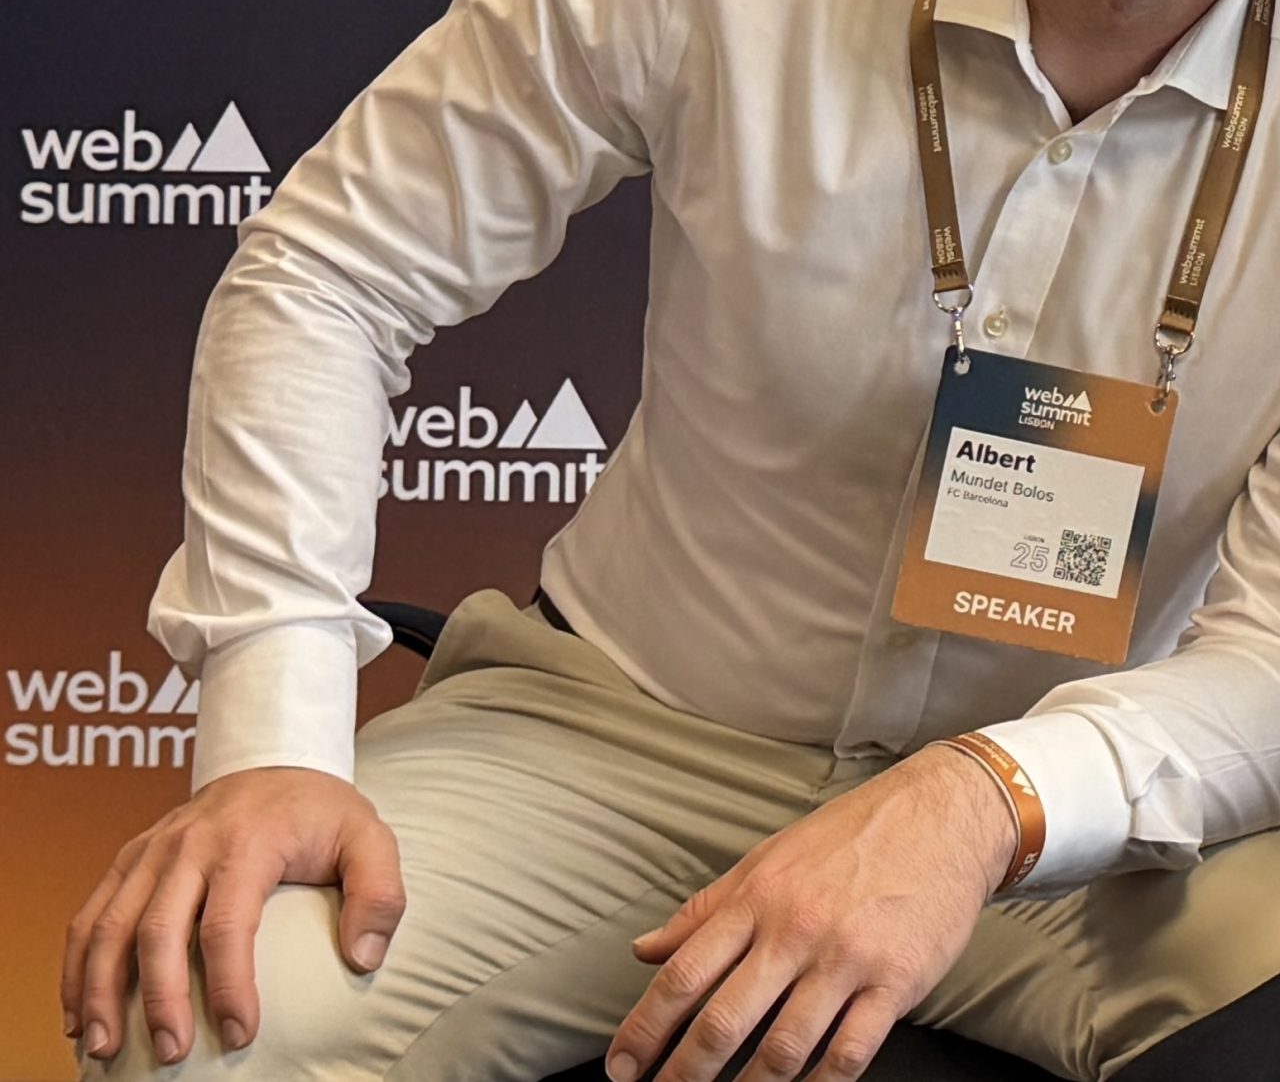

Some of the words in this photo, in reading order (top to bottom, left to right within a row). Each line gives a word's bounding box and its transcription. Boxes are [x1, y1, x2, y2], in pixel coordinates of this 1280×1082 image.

[927, 82, 943, 153] websummit
[1220, 84, 1248, 149] websummit
[1231, 116, 1249, 152] LISBON
[22, 110, 162, 171] web
[21, 176, 271, 225] summit
[1179, 217, 1206, 285] websummit
[1189, 251, 1207, 286] LISBON
[1020, 400, 1093, 427] summit
[1024, 386, 1063, 407] web
[1018, 415, 1056, 430] LISBON
[955, 440, 1036, 474] Albert
[378, 452, 606, 504] ummit
[946, 487, 961, 500] FC
[963, 490, 1009, 508] Barcelona
[950, 469, 1008, 493] Mundet
[1013, 482, 1055, 503] Bolos
[1010, 542, 1050, 573] 25
[953, 590, 1077, 635] SPEAKER
[7, 651, 148, 713] web
[5, 723, 196, 768] summ
